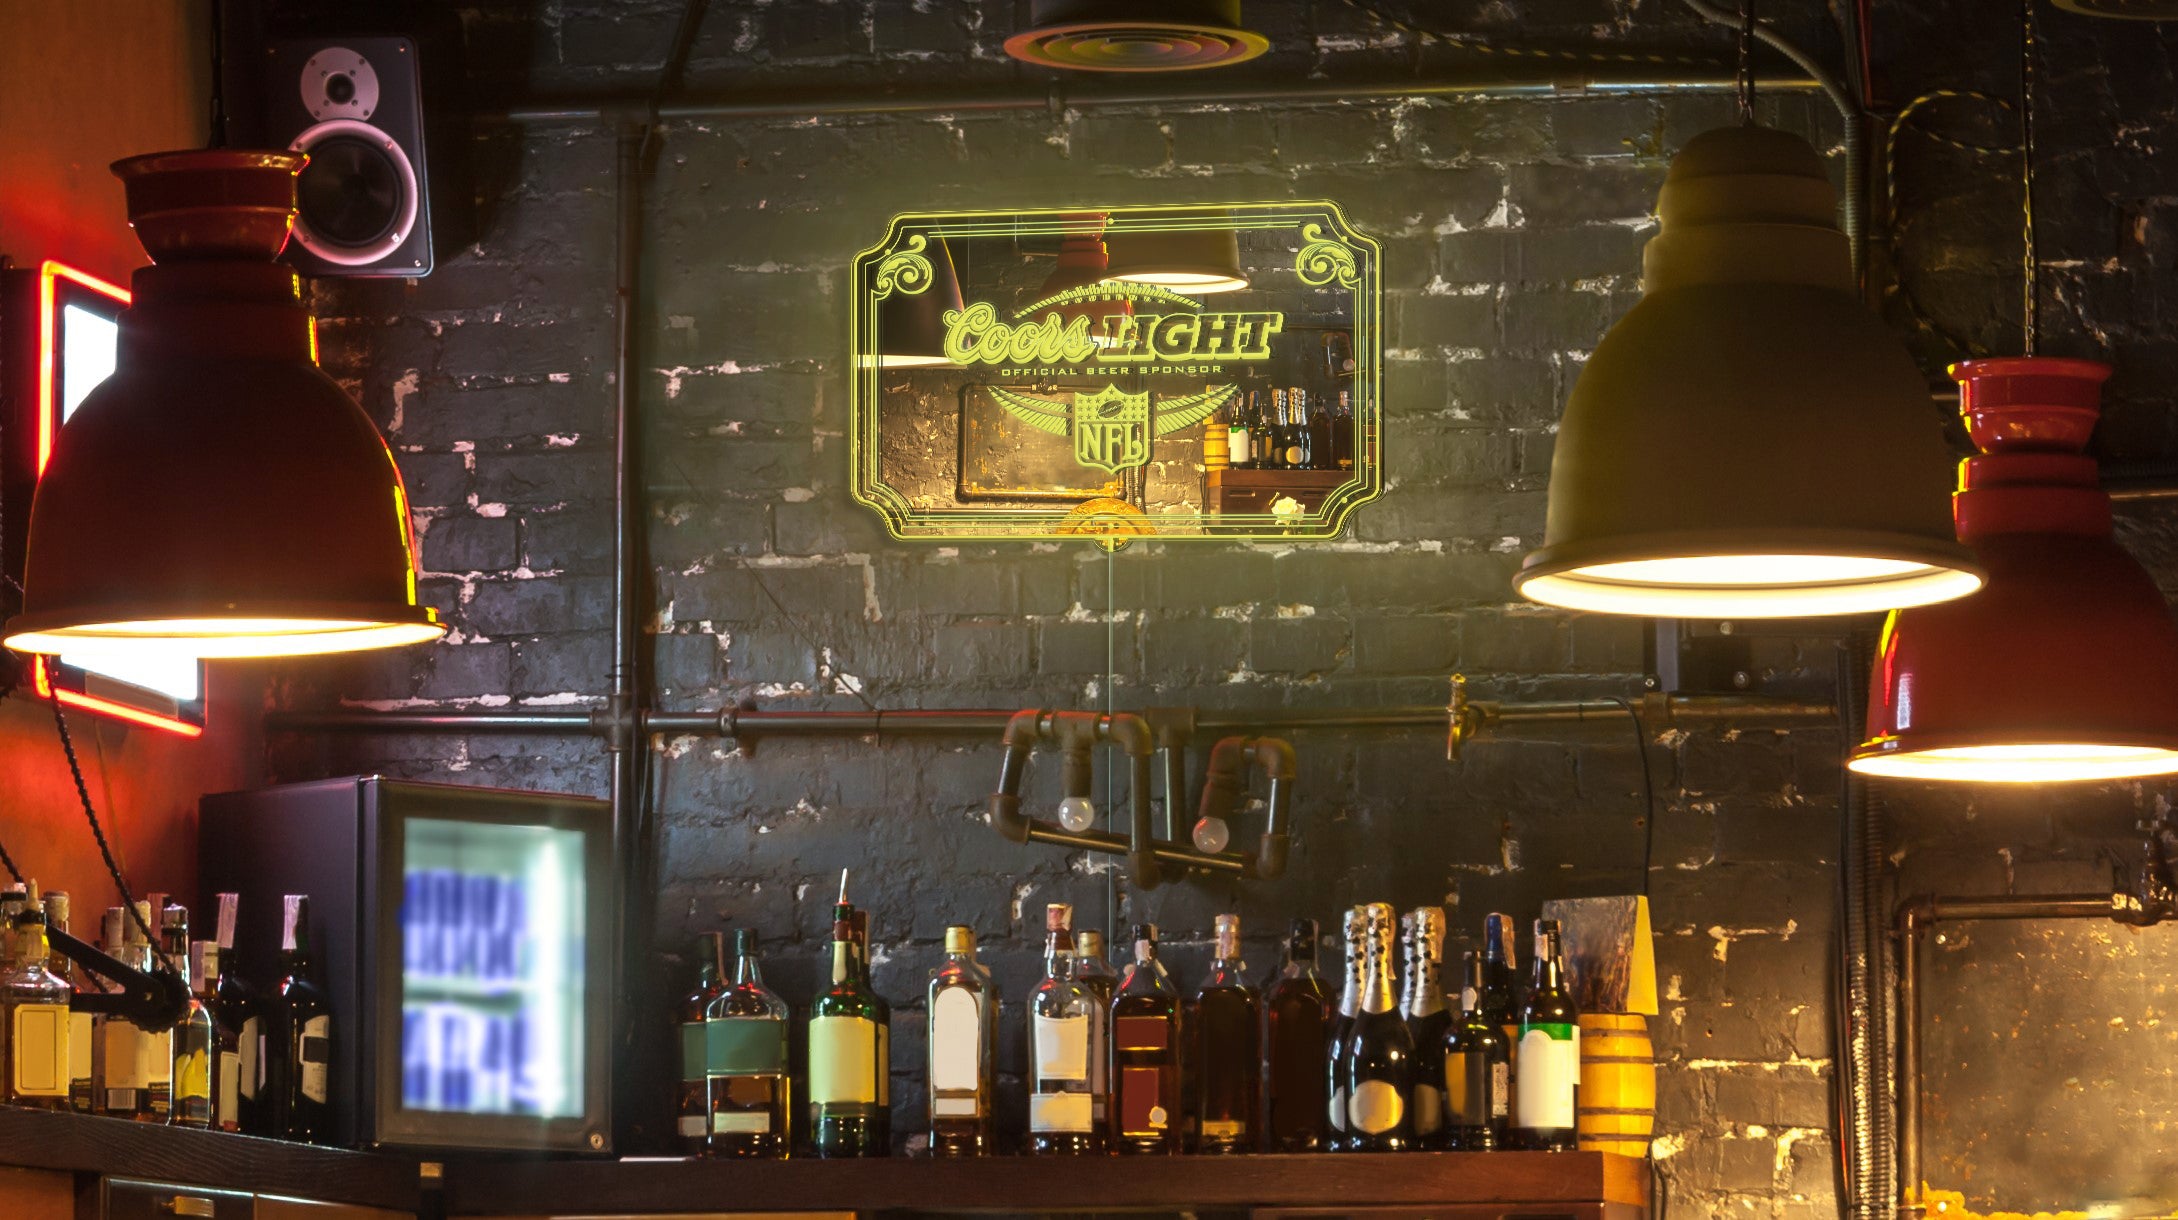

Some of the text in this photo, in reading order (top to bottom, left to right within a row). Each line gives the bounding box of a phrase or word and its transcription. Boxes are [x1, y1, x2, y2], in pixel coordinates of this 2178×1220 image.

[943, 302, 1284, 365] Coors LIGHT
[1001, 365, 1221, 376] OFFICIAL BEER SPONSOR
[1080, 423, 1143, 467] NFL
